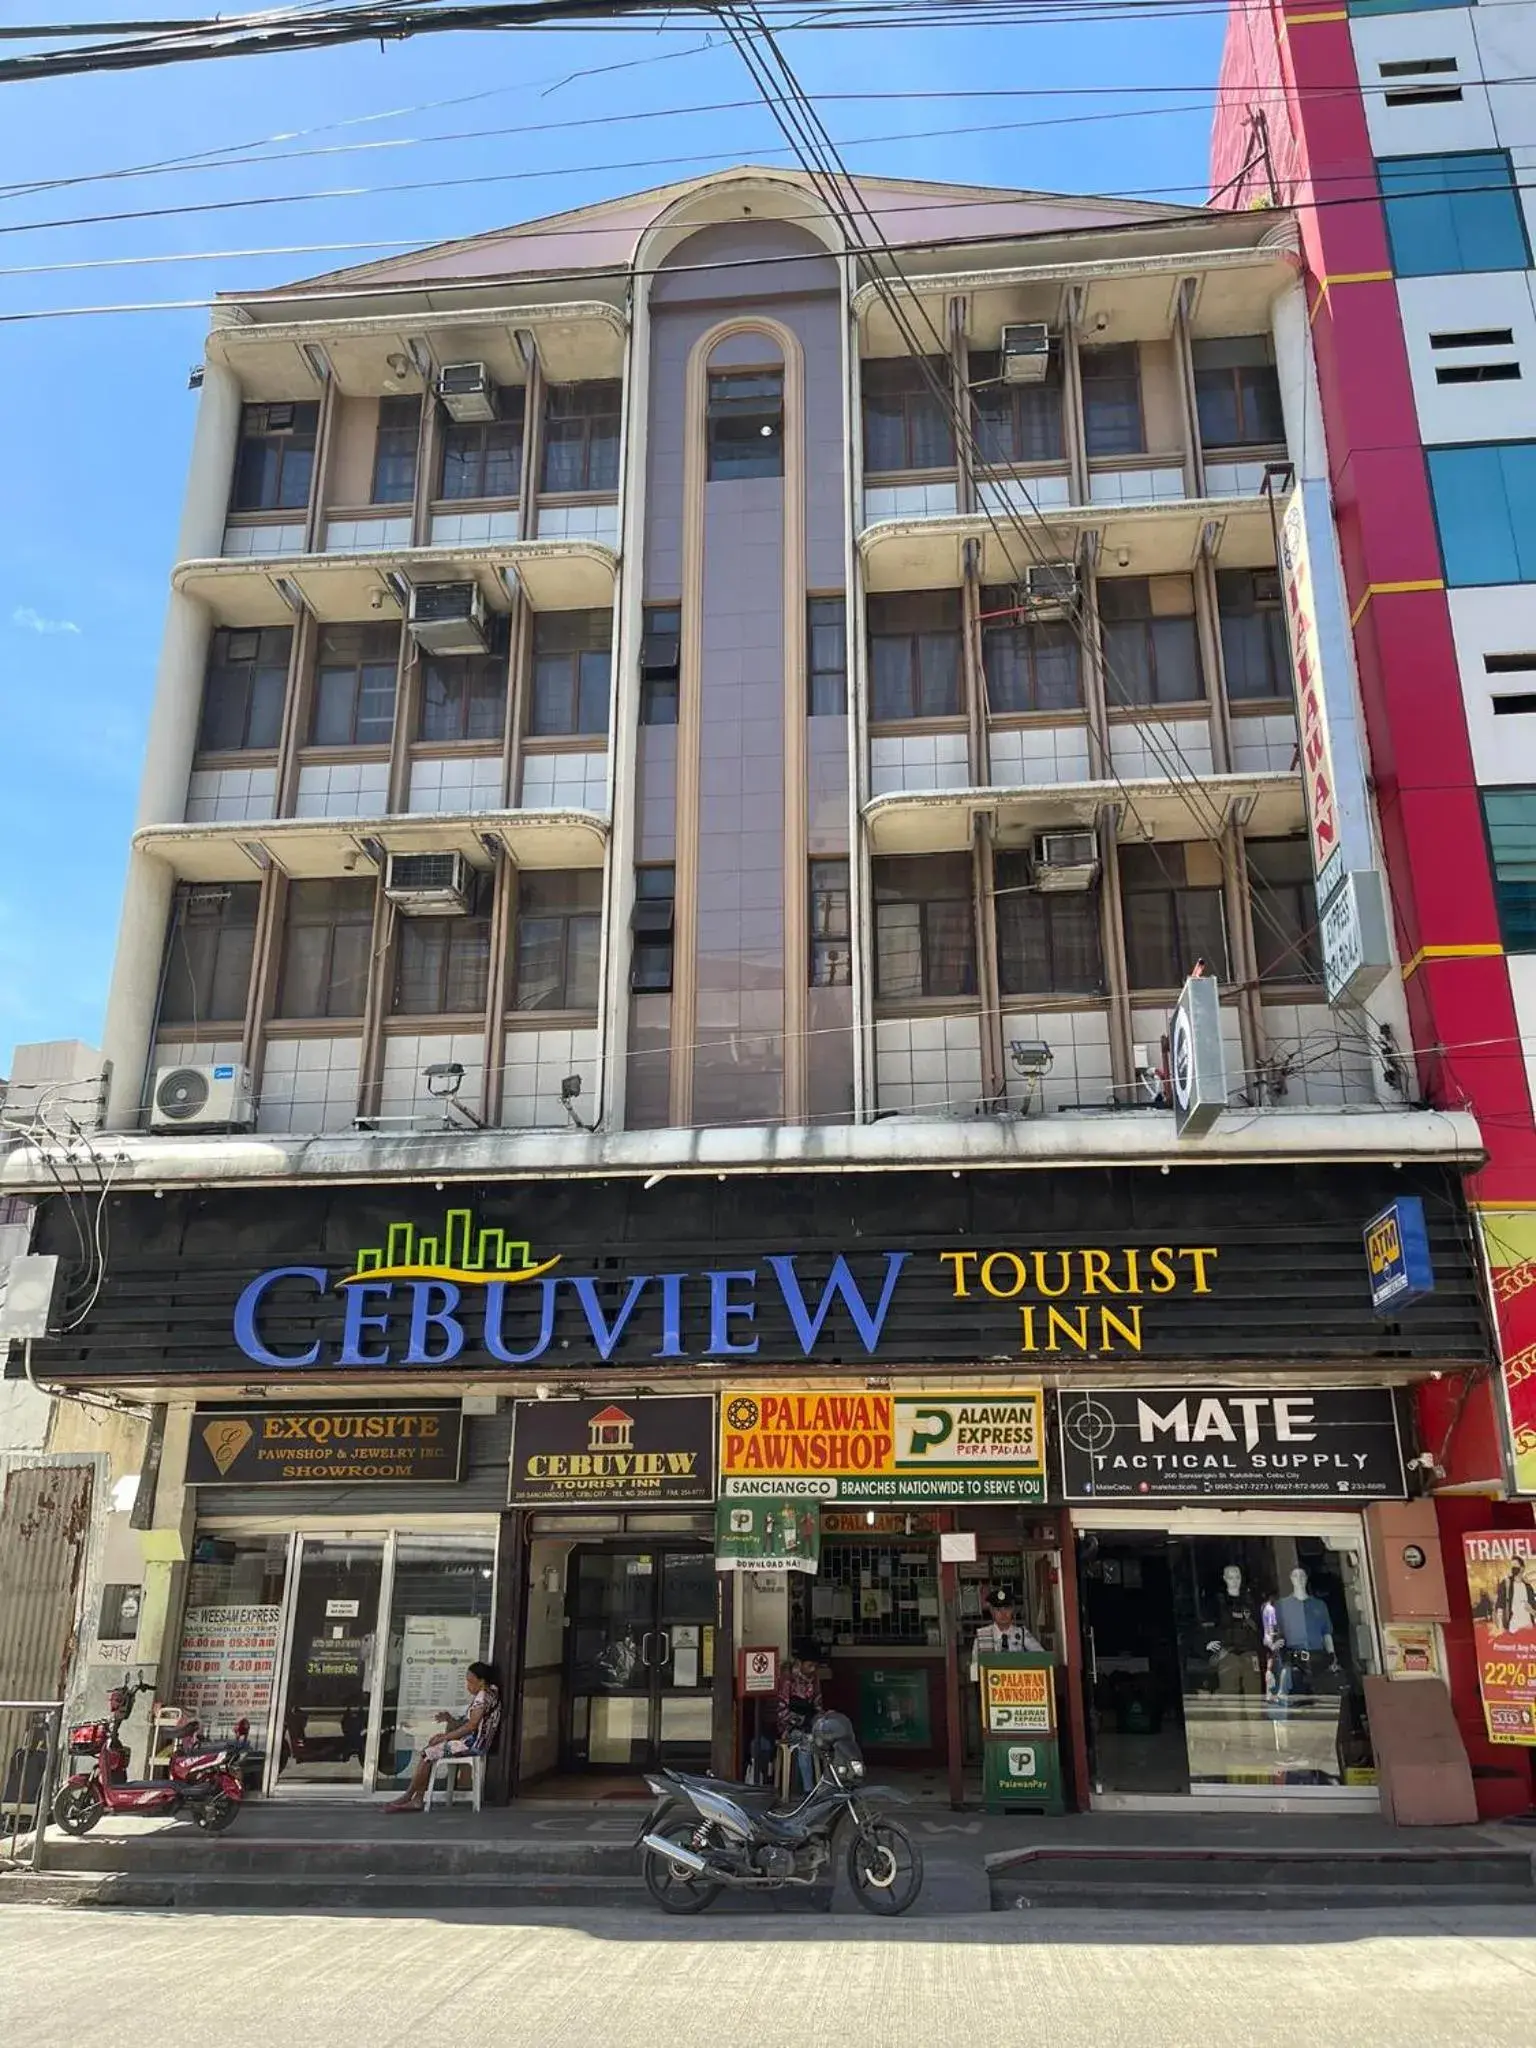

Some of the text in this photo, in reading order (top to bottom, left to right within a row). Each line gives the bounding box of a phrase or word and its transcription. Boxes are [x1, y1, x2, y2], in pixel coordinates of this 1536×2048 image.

[940, 1248, 1218, 1297] TOURIST
[233, 1252, 914, 1367] CEBUVIEW
[1019, 1305, 1144, 1352] INN
[760, 1397, 892, 1431] PALAWAN
[262, 1416, 440, 1444] EXQUISITE
[1137, 1398, 1318, 1453] MATE
[957, 1427, 1034, 1444] EXPRESS
[257, 1448, 333, 1460] PAWNSHOP
[336, 1448, 347, 1459] &
[350, 1447, 416, 1460] JEWELRY
[726, 1434, 892, 1469] PAWNSHOP
[957, 1444, 1032, 1455] PERA PADALA
[527, 1452, 698, 1477] CEBUVIEW
[1094, 1453, 1369, 1471] TACTICAL SUPPLY
[282, 1465, 413, 1478] SHOWROOM
[554, 1479, 661, 1489] TOURIST INN
[733, 1481, 831, 1495] SANCIANGCO
[841, 1479, 1040, 1495] BRANCHES NATIONWIDE TO SERVE YOU
[1466, 1538, 1536, 1561] TRAVEL
[736, 1560, 784, 1569] DOWNLOAD
[240, 1608, 279, 1622] EXPRESS
[254, 1660, 272, 1672] pm
[1000, 1673, 1044, 1687] PALAWAN
[1485, 1662, 1526, 1687] 22%
[991, 1687, 1045, 1702] PAWNSHOP
[1000, 1779, 1047, 1790] PalawanPay
